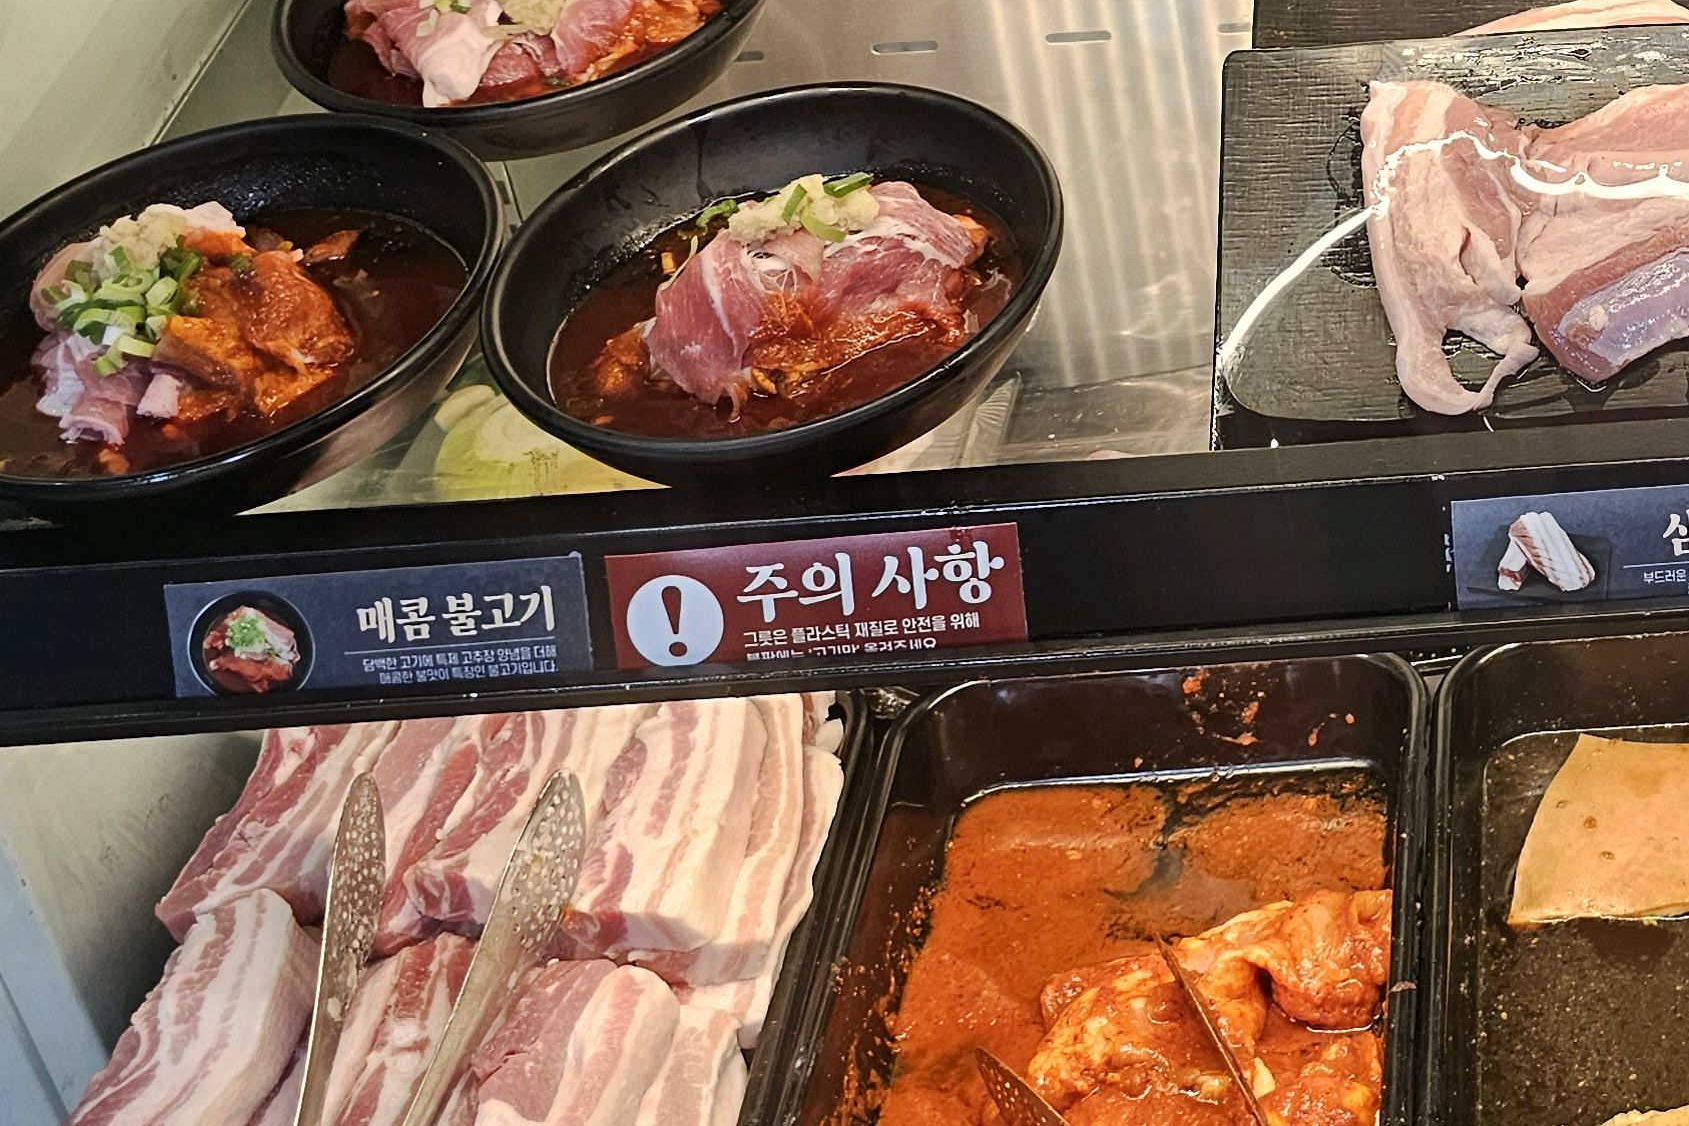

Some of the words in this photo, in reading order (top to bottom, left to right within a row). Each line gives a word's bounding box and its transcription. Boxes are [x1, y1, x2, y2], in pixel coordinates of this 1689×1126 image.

[736, 552, 855, 623] 주의
[871, 540, 1005, 610] 사항
[1644, 569, 1686, 584] 부드러운
[356, 597, 436, 643] 매콤
[442, 585, 555, 636] 불고기
[743, 630, 788, 648] 그릇은
[791, 623, 850, 644] 플라스틱
[854, 619, 899, 638] 재질로
[902, 614, 947, 634] 안전을
[950, 612, 980, 629] 위해
[400, 654, 434, 669] 고기에
[461, 649, 495, 664] 고추장
[533, 644, 557, 658] 더해
